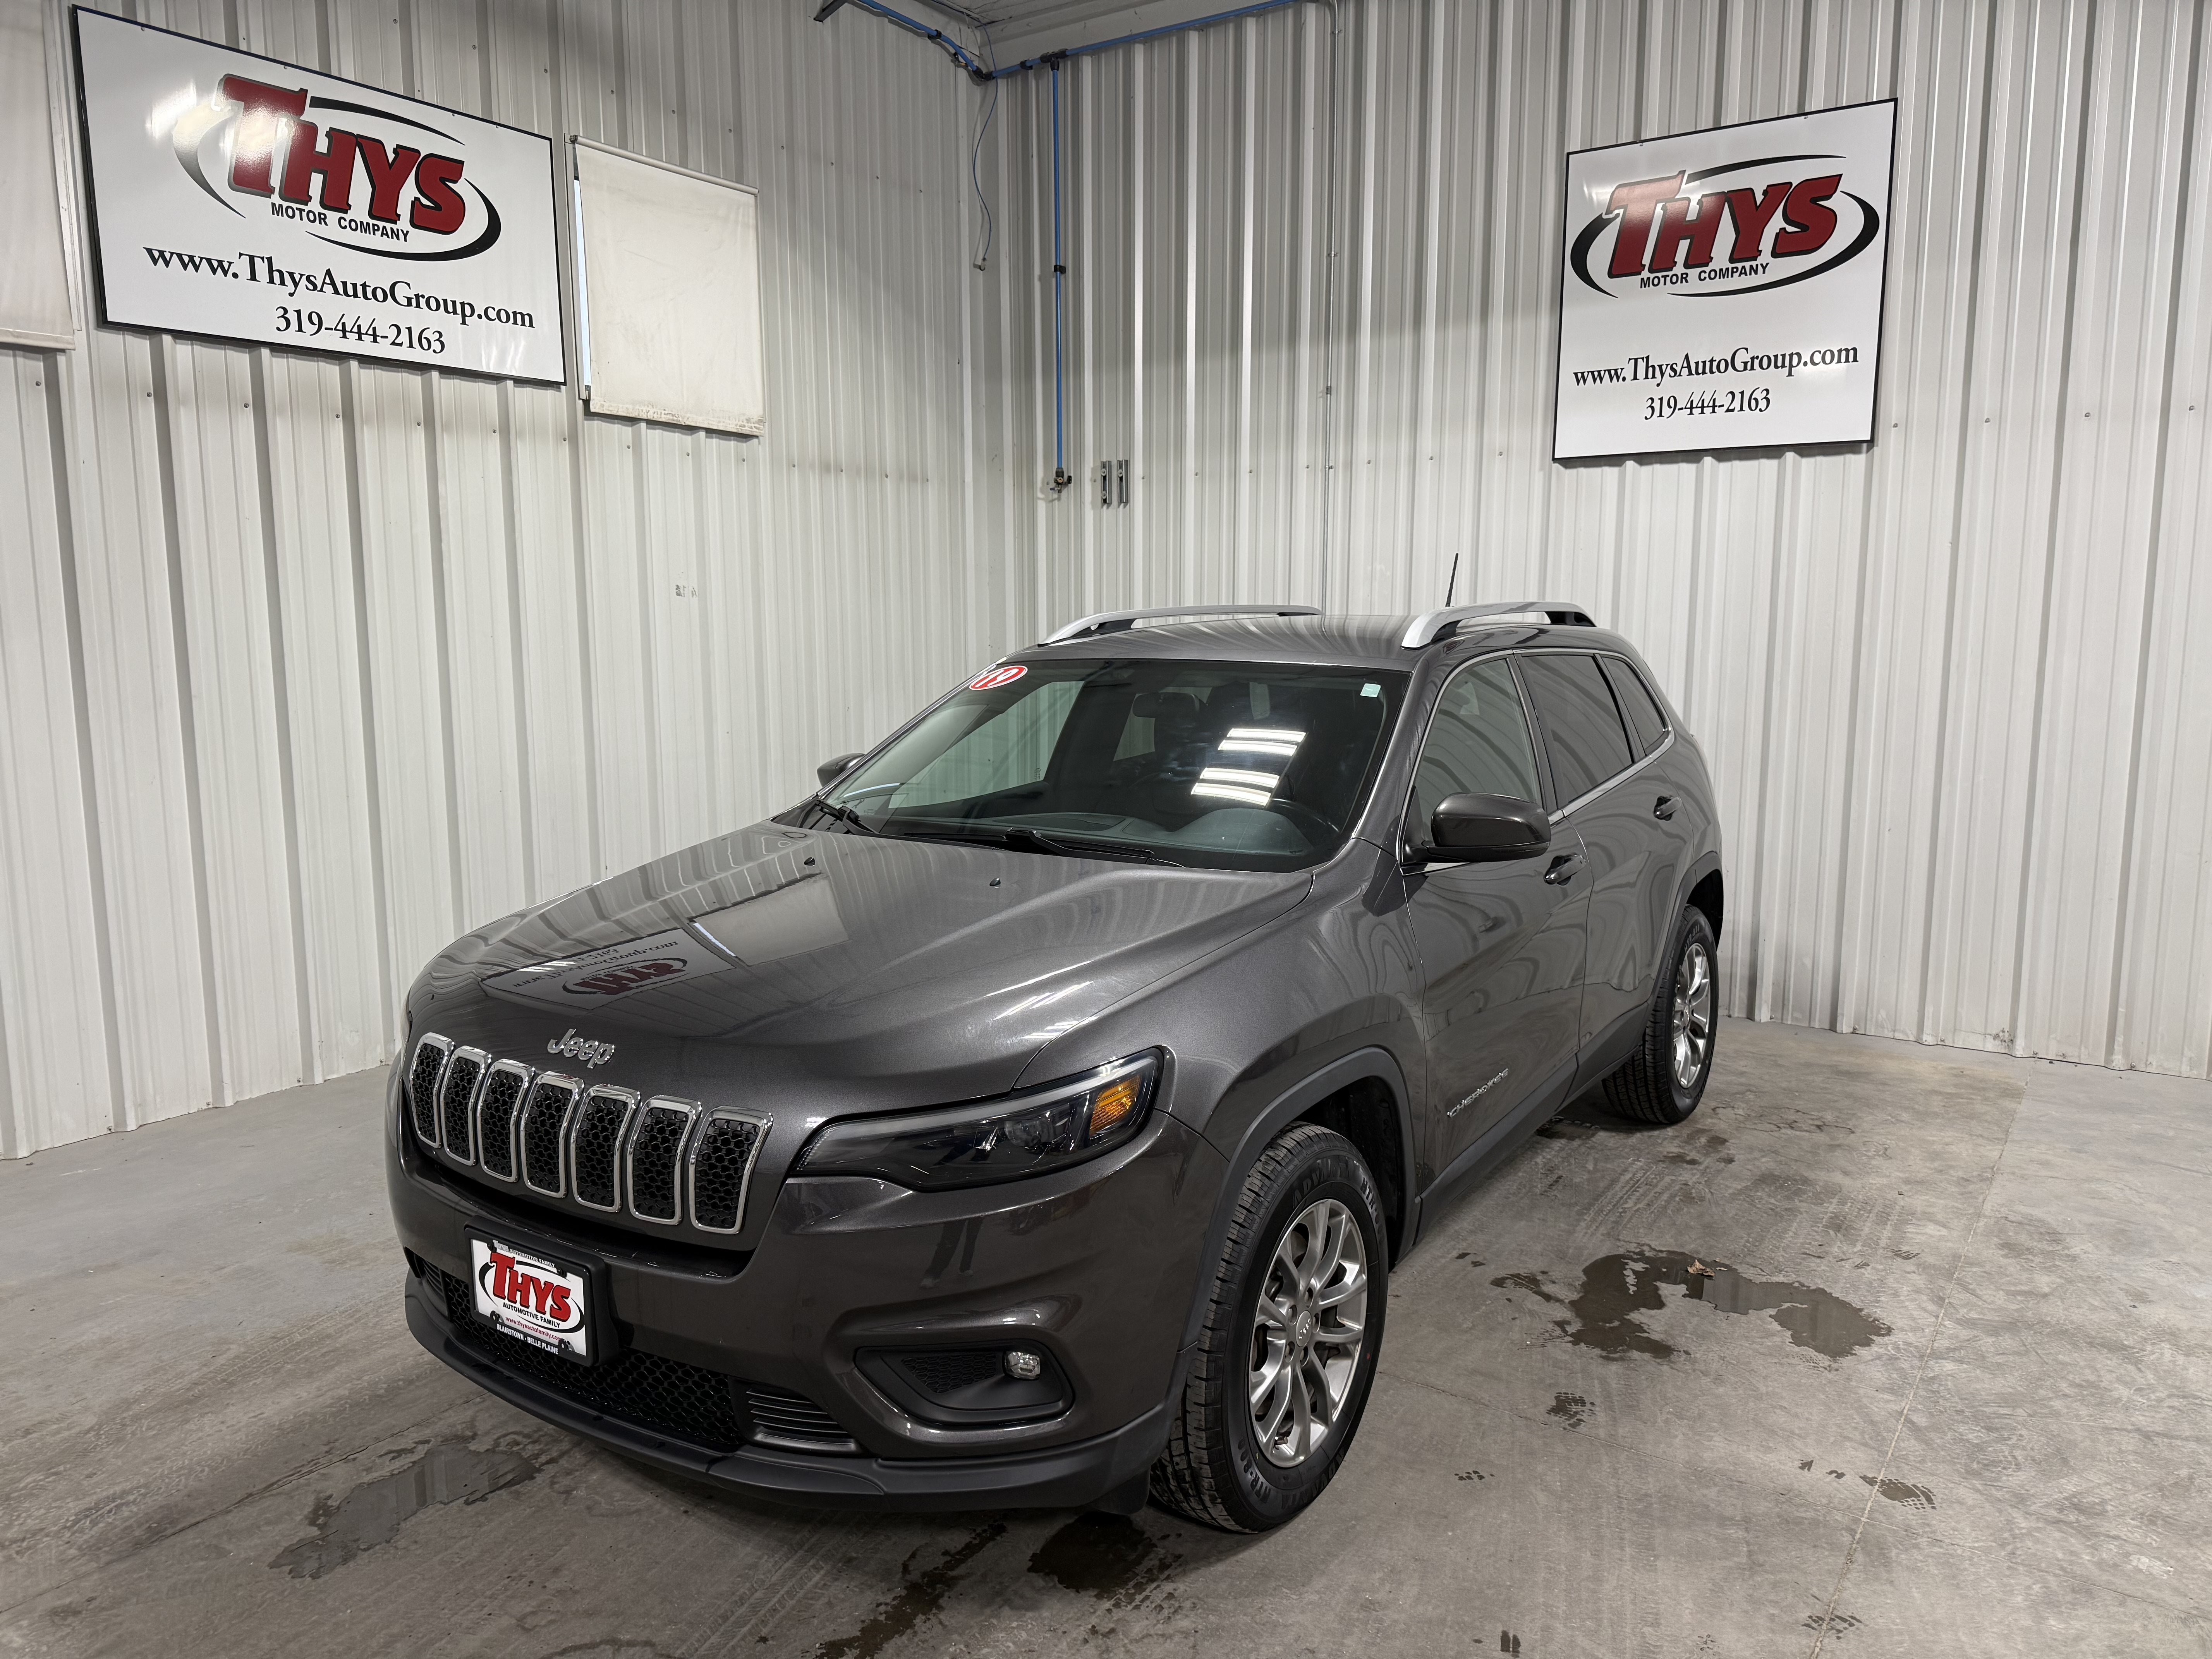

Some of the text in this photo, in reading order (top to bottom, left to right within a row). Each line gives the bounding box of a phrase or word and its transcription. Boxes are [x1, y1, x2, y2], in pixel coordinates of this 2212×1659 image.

[210, 73, 465, 235] THYS
[271, 202, 409, 242] MOTOR COMPANY
[1605, 170, 1843, 278] THYS
[143, 247, 535, 329] www.ThysAutoGroup.com
[1640, 263, 1769, 289] MOTOR COMPANY
[276, 306, 445, 354] 319-444-2163
[1573, 347, 1859, 386] www.ThysAutoGroup.com
[1644, 387, 1770, 420] 319-444-2163
[547, 1029, 615, 1069] Jeep
[490, 1252, 571, 1322] THYS
[503, 1302, 560, 1329] AUTOMOTIVE FAMILY
[497, 1324, 559, 1355] BLAIRSTOWN BELLE PLAINE
